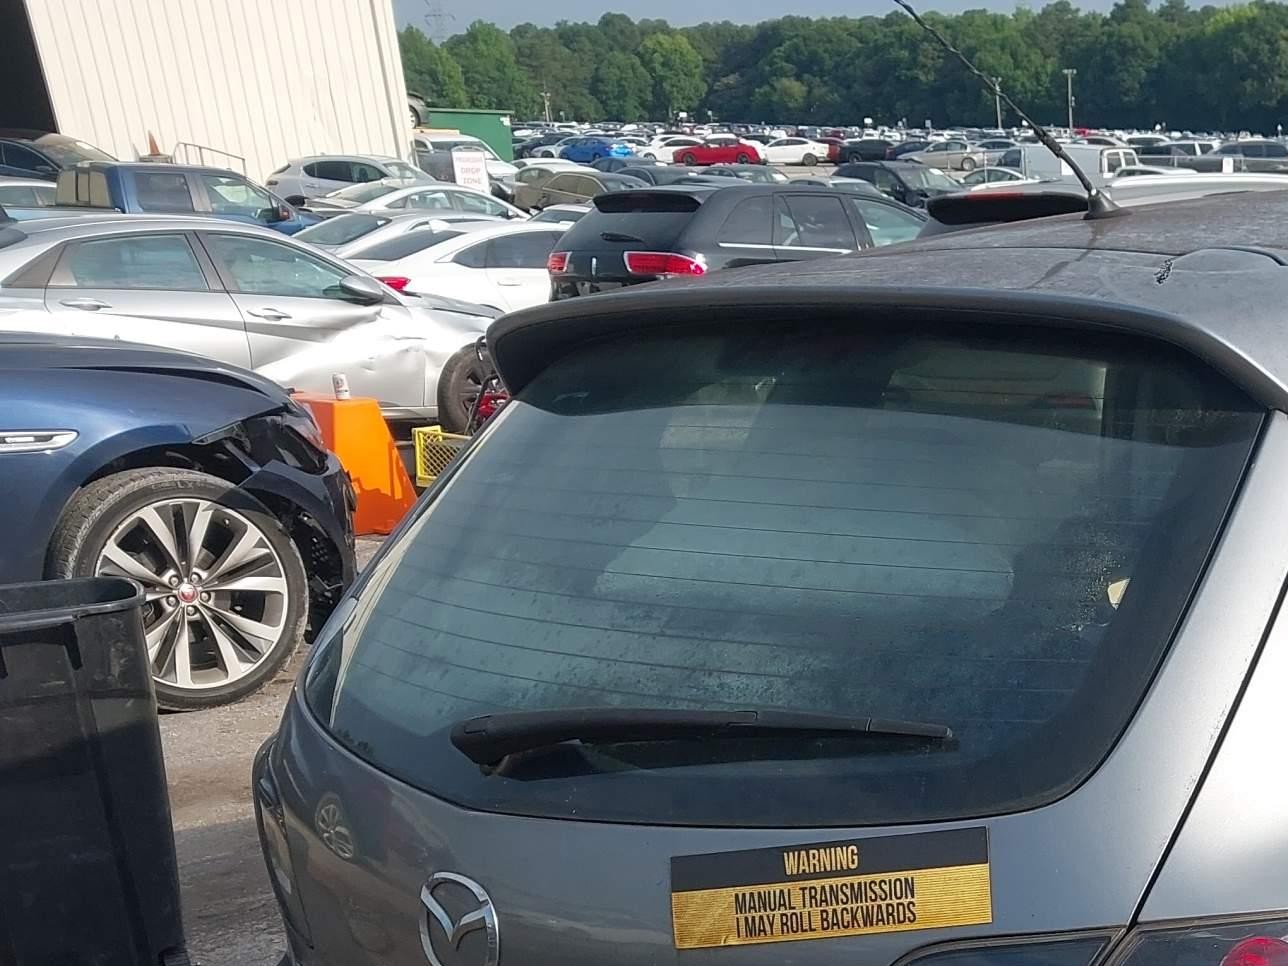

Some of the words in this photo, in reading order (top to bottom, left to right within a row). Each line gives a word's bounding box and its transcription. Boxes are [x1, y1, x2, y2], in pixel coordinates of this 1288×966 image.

[783, 845, 859, 875] WARNING
[734, 888, 796, 915] MANUAL
[799, 876, 915, 909] TRANSMISSION
[735, 917, 741, 939] I
[745, 914, 776, 938] MAY
[780, 911, 816, 935] ROLL
[820, 901, 917, 931] BACKWARDS
